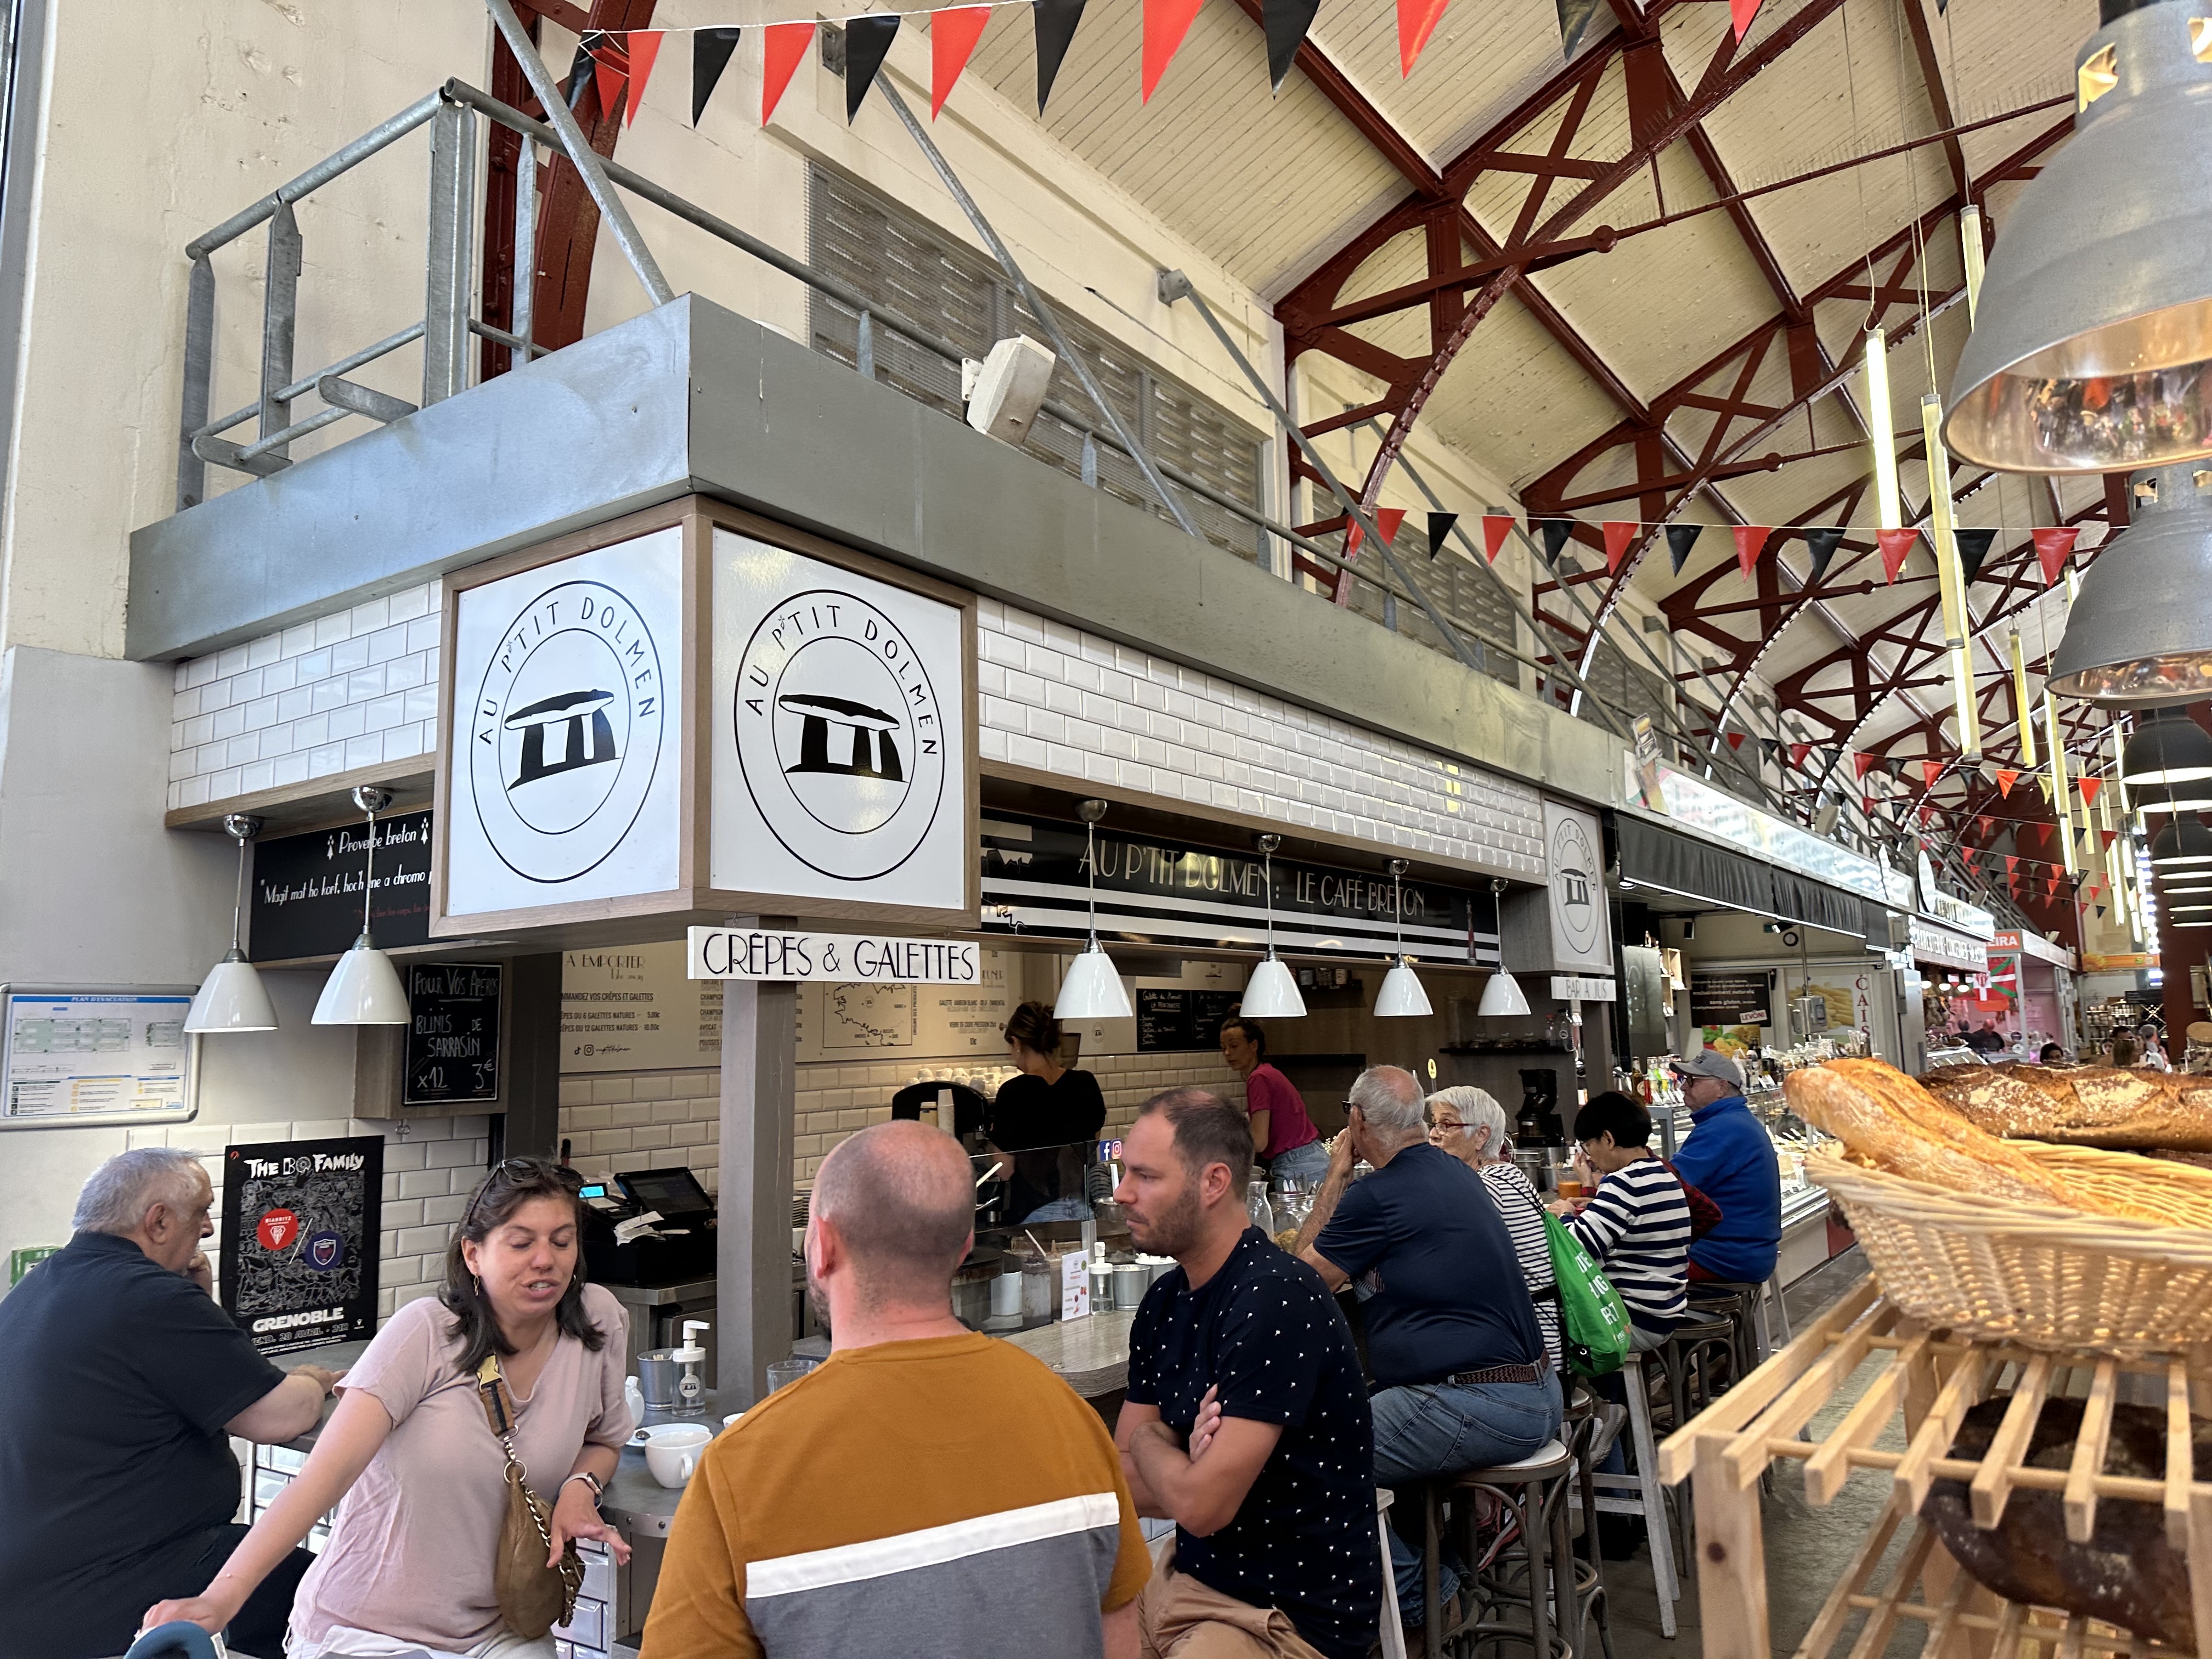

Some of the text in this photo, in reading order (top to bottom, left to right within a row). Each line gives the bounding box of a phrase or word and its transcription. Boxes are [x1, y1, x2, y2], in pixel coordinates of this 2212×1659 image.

[479, 699, 498, 745] AU
[581, 596, 656, 718] DOLMEN
[745, 664, 769, 716] AU
[864, 619, 938, 754] DOLMEN
[338, 823, 417, 854] Proverbe breton
[291, 883, 307, 900] mat
[308, 878, 319, 898] ho
[384, 877, 390, 887] a
[393, 864, 426, 885] chromo
[1078, 839, 1119, 878] AU
[1125, 843, 1180, 885] P'TIT
[1185, 851, 1269, 898] DOLMEN
[1296, 871, 1316, 904] LE
[1321, 874, 1363, 910] CAFÉ
[1368, 882, 1425, 917] BRETON
[1987, 935, 2018, 947] EIRA
[582, 954, 646, 968] EMPORTER
[703, 932, 974, 981] CRÊPES & GALETTES
[602, 991, 622, 1001] CRÊPES
[1566, 979, 1580, 998] BAR
[1594, 981, 1607, 998] JUS
[472, 1018, 482, 1031] DE
[1741, 1011, 1765, 1020] LEVONI
[472, 1059, 495, 1089] 3€
[244, 1153, 364, 1178] THE BO FAMILY
[252, 1307, 345, 1332] GRENOBLE
[251, 1335, 276, 1346] END.
[279, 1332, 292, 1341] 28
[294, 1327, 324, 1339] AVRIL
